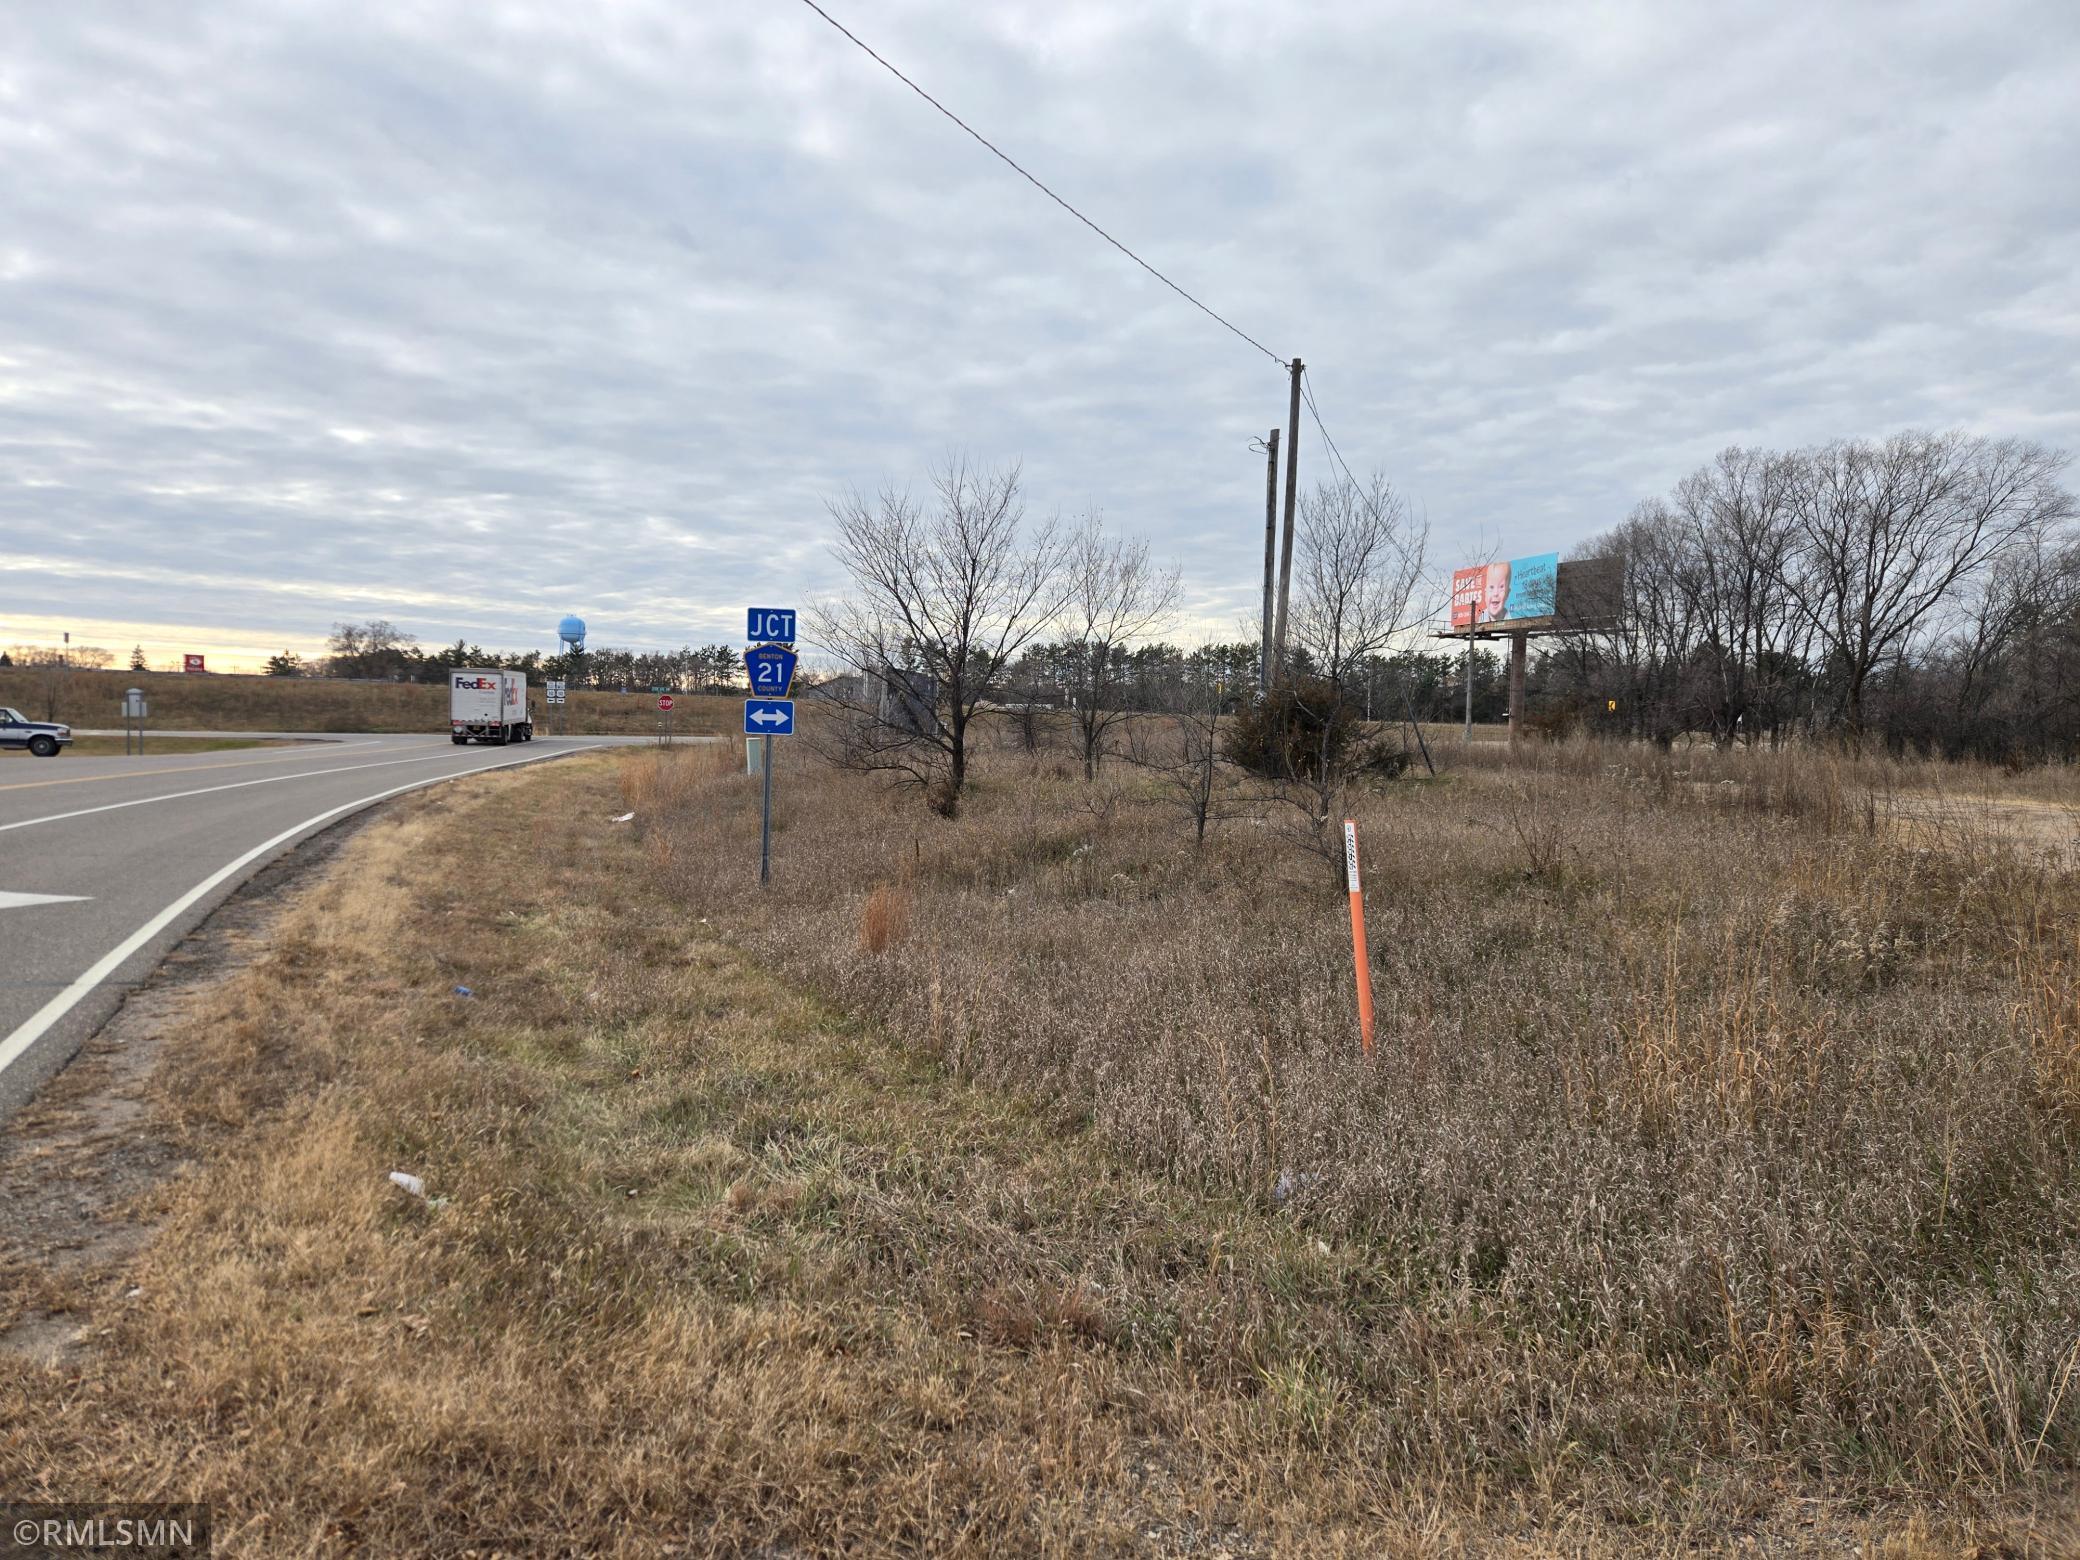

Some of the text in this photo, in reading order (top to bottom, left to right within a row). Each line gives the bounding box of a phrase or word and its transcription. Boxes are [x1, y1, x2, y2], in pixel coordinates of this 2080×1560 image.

[1455, 576, 1475, 591] SAVE
[1454, 590, 1482, 606] BABIES
[750, 613, 793, 637] JCT
[758, 662, 782, 683] 21
[455, 677, 496, 690] FedEx
[659, 699, 673, 707] STOP
